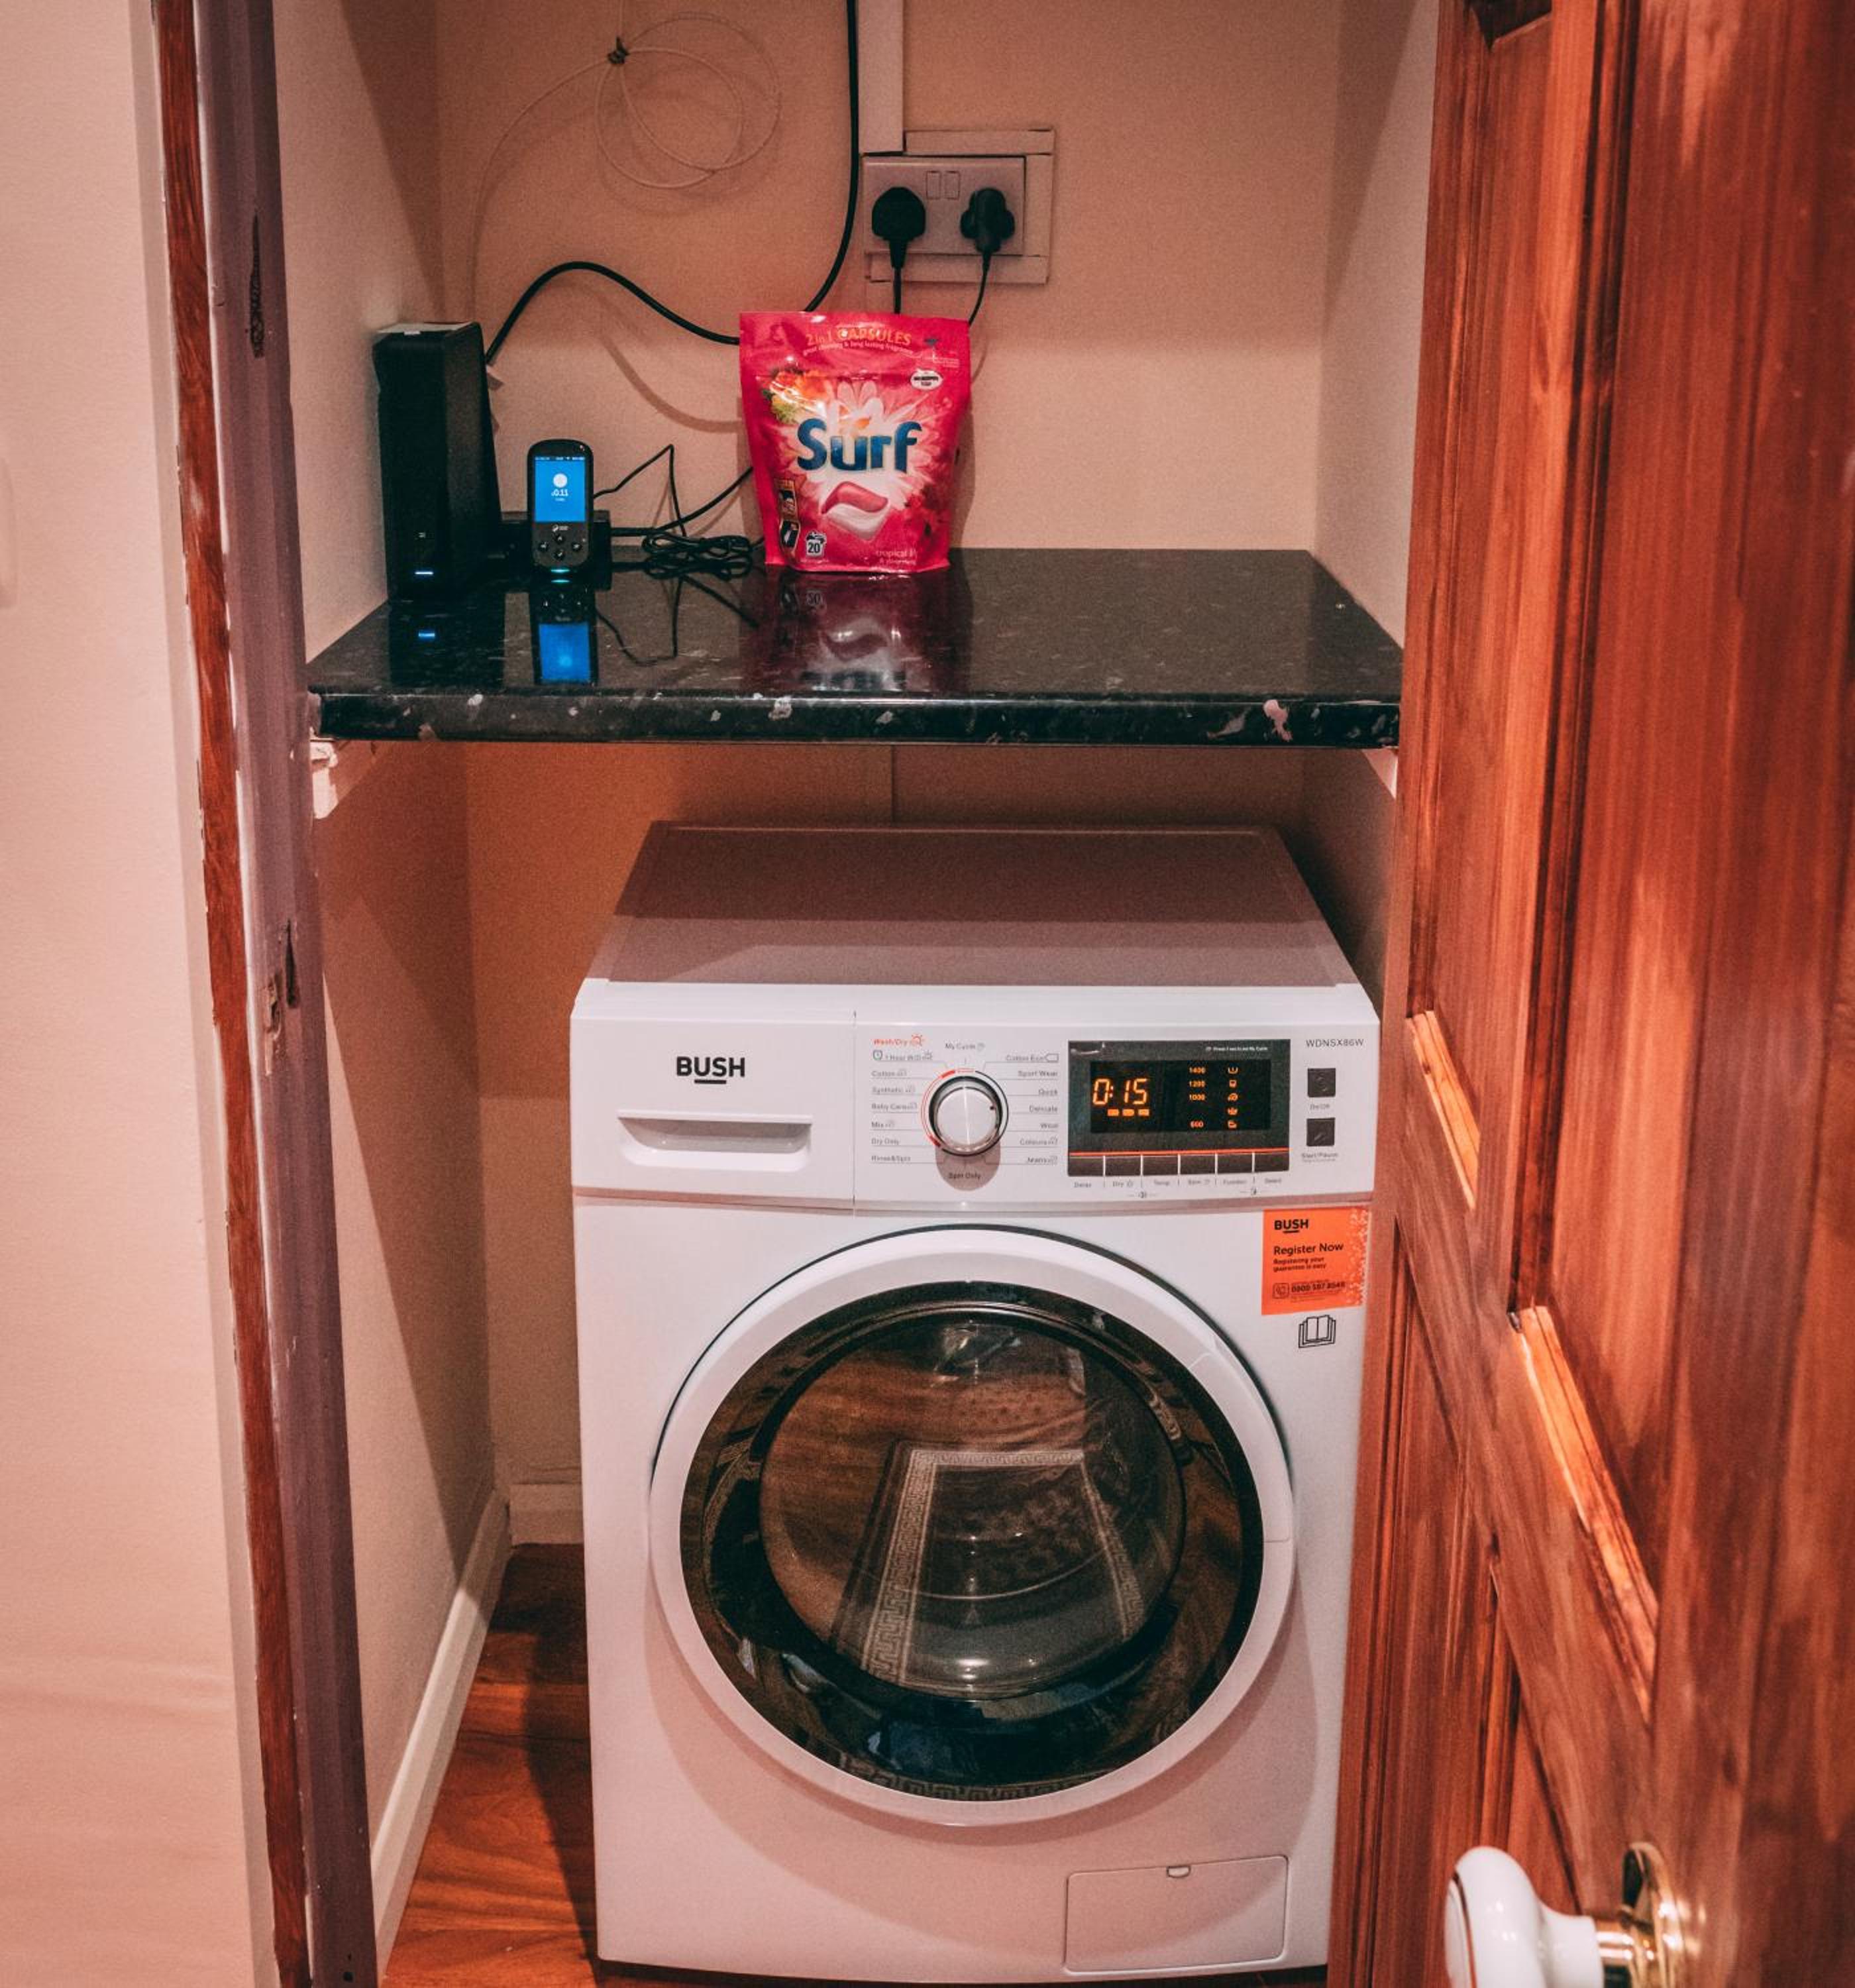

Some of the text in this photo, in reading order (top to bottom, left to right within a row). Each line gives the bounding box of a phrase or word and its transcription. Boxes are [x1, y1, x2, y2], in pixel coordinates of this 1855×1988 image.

[837, 328, 912, 345] CAPSULES
[797, 418, 922, 474] Surf
[808, 542, 820, 553] 20
[1306, 1038, 1364, 1048] WDNSX86W
[676, 1056, 745, 1077] BUSH
[1092, 1077, 1149, 1105] 0:15
[1274, 1219, 1309, 1231] BUSH
[1273, 1242, 1344, 1257] Register Now
